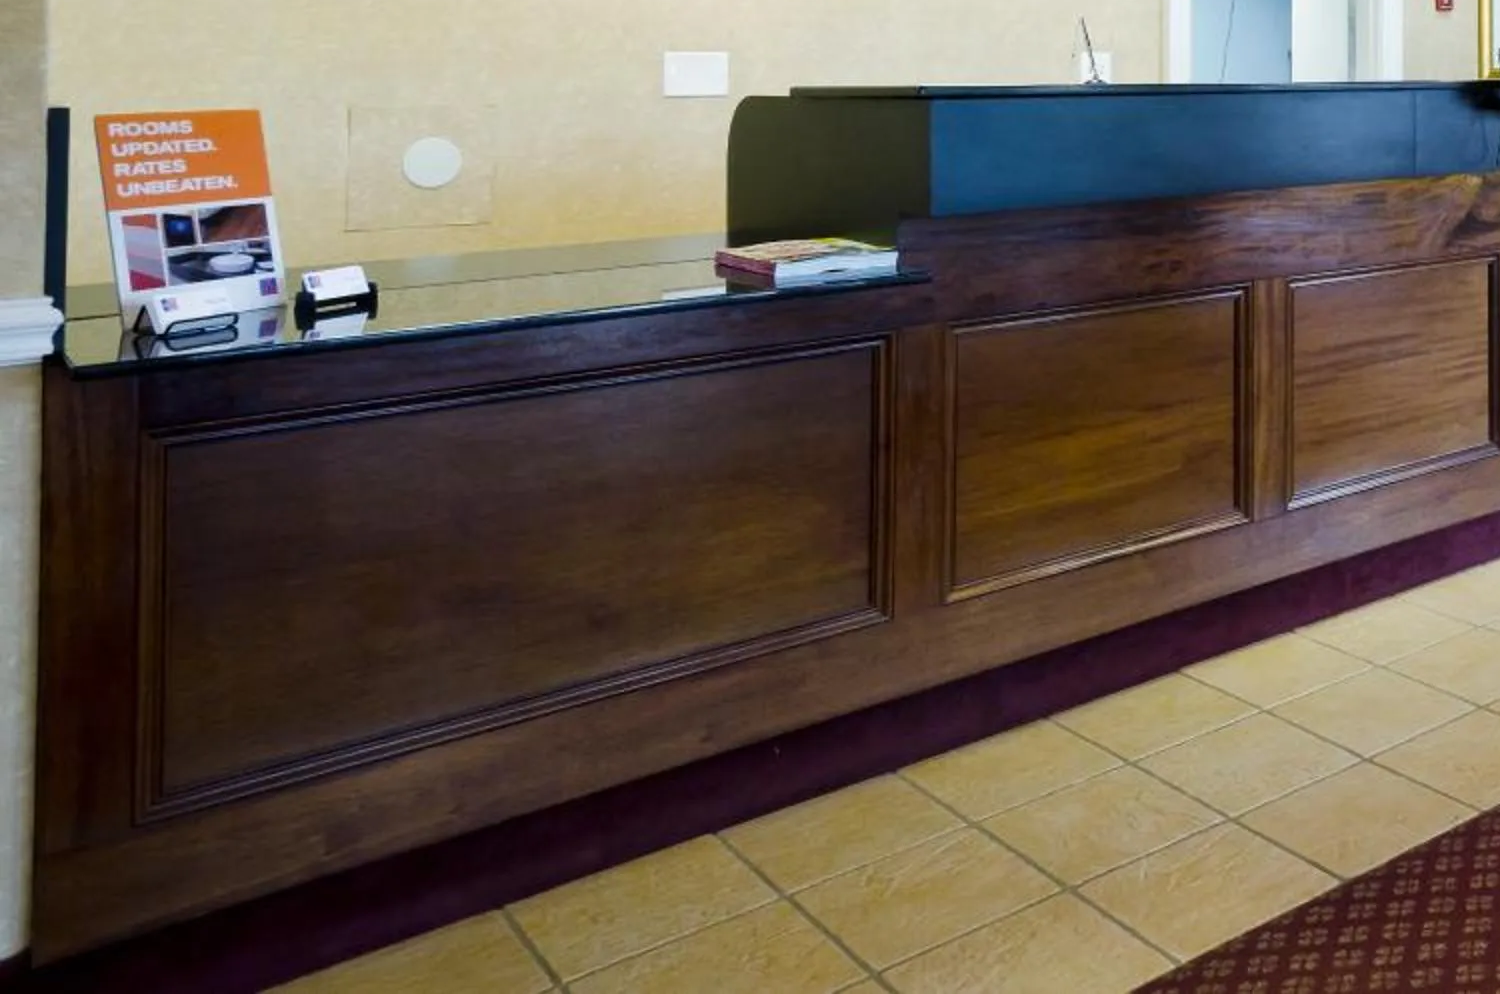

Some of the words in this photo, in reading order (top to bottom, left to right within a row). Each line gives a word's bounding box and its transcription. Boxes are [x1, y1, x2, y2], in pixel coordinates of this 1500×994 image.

[107, 119, 192, 137] ROOMS
[111, 138, 217, 157] UPDATED.
[113, 158, 188, 177] RATES
[116, 175, 239, 198] UNBEATEN.
